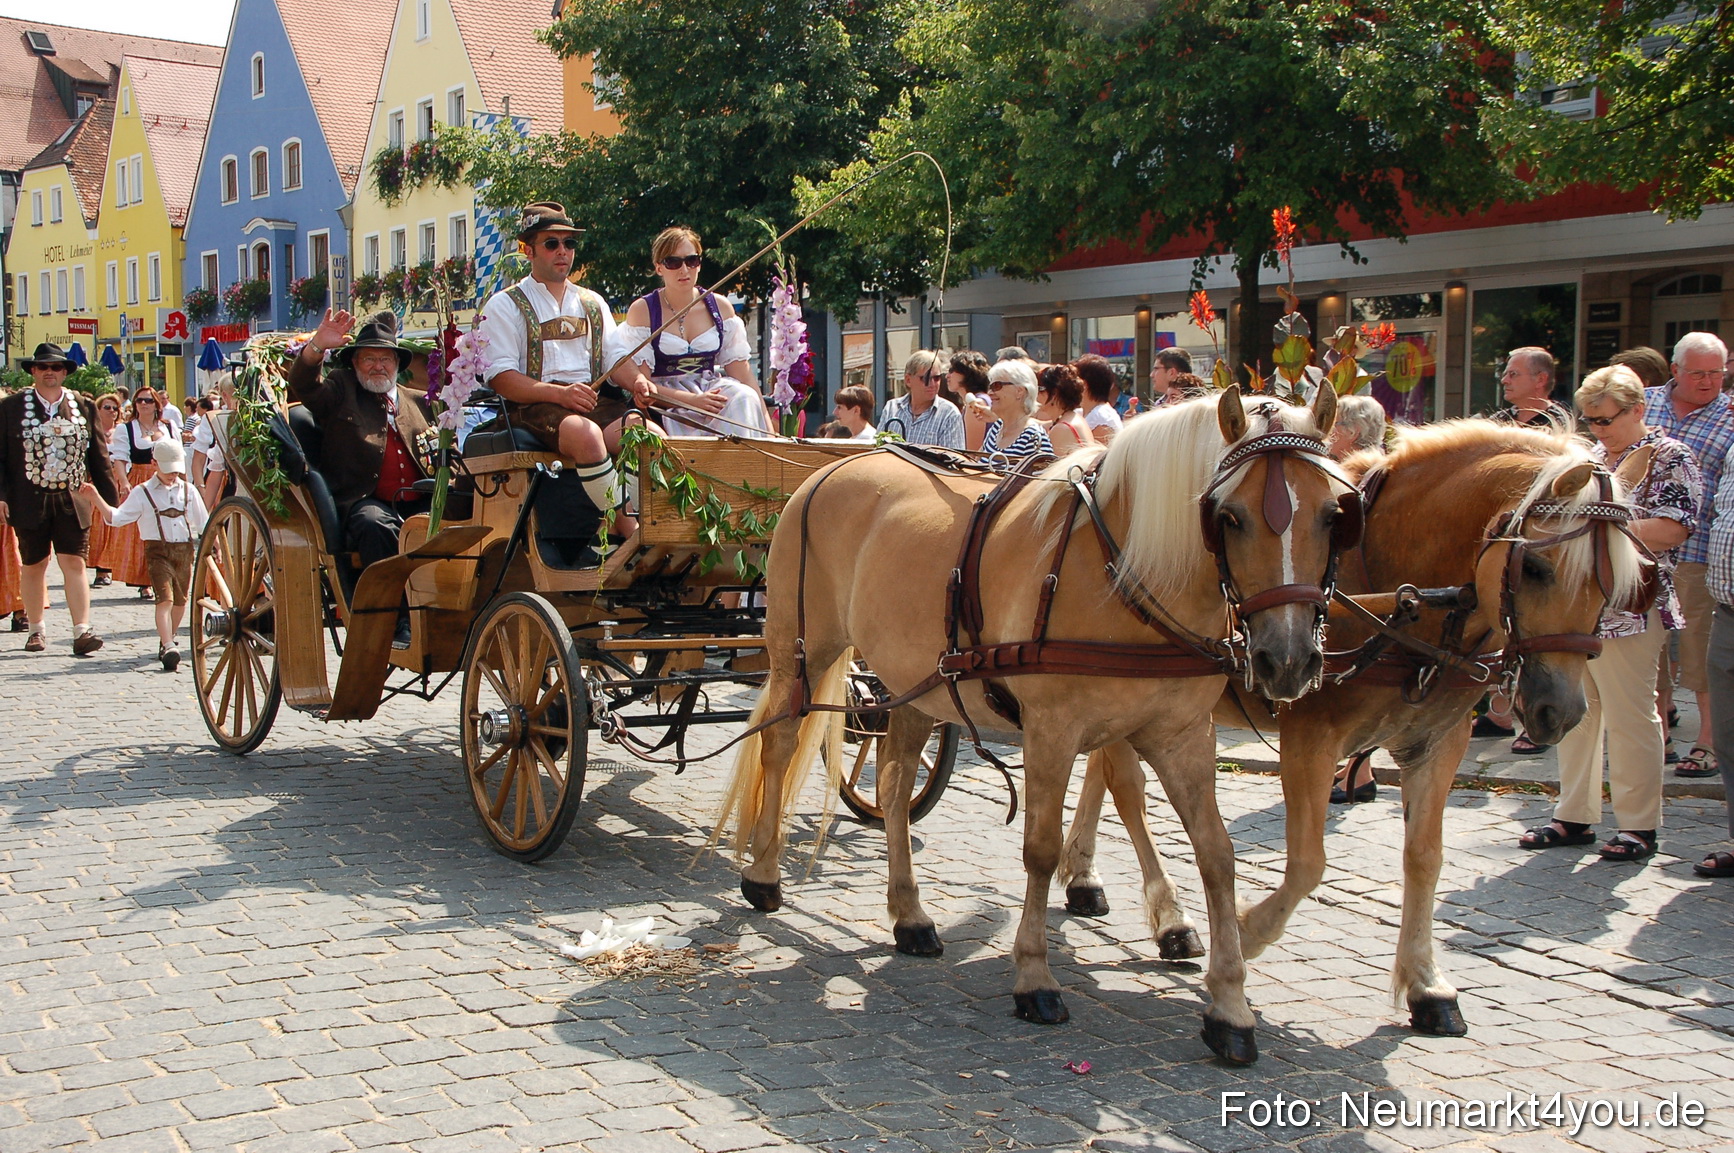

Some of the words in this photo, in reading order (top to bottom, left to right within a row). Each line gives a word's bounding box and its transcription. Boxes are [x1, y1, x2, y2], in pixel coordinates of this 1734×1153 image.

[44, 245, 65, 263] HOTEL
[69, 322, 97, 330] WISSMAC
[1391, 352, 1417, 378] 70%
